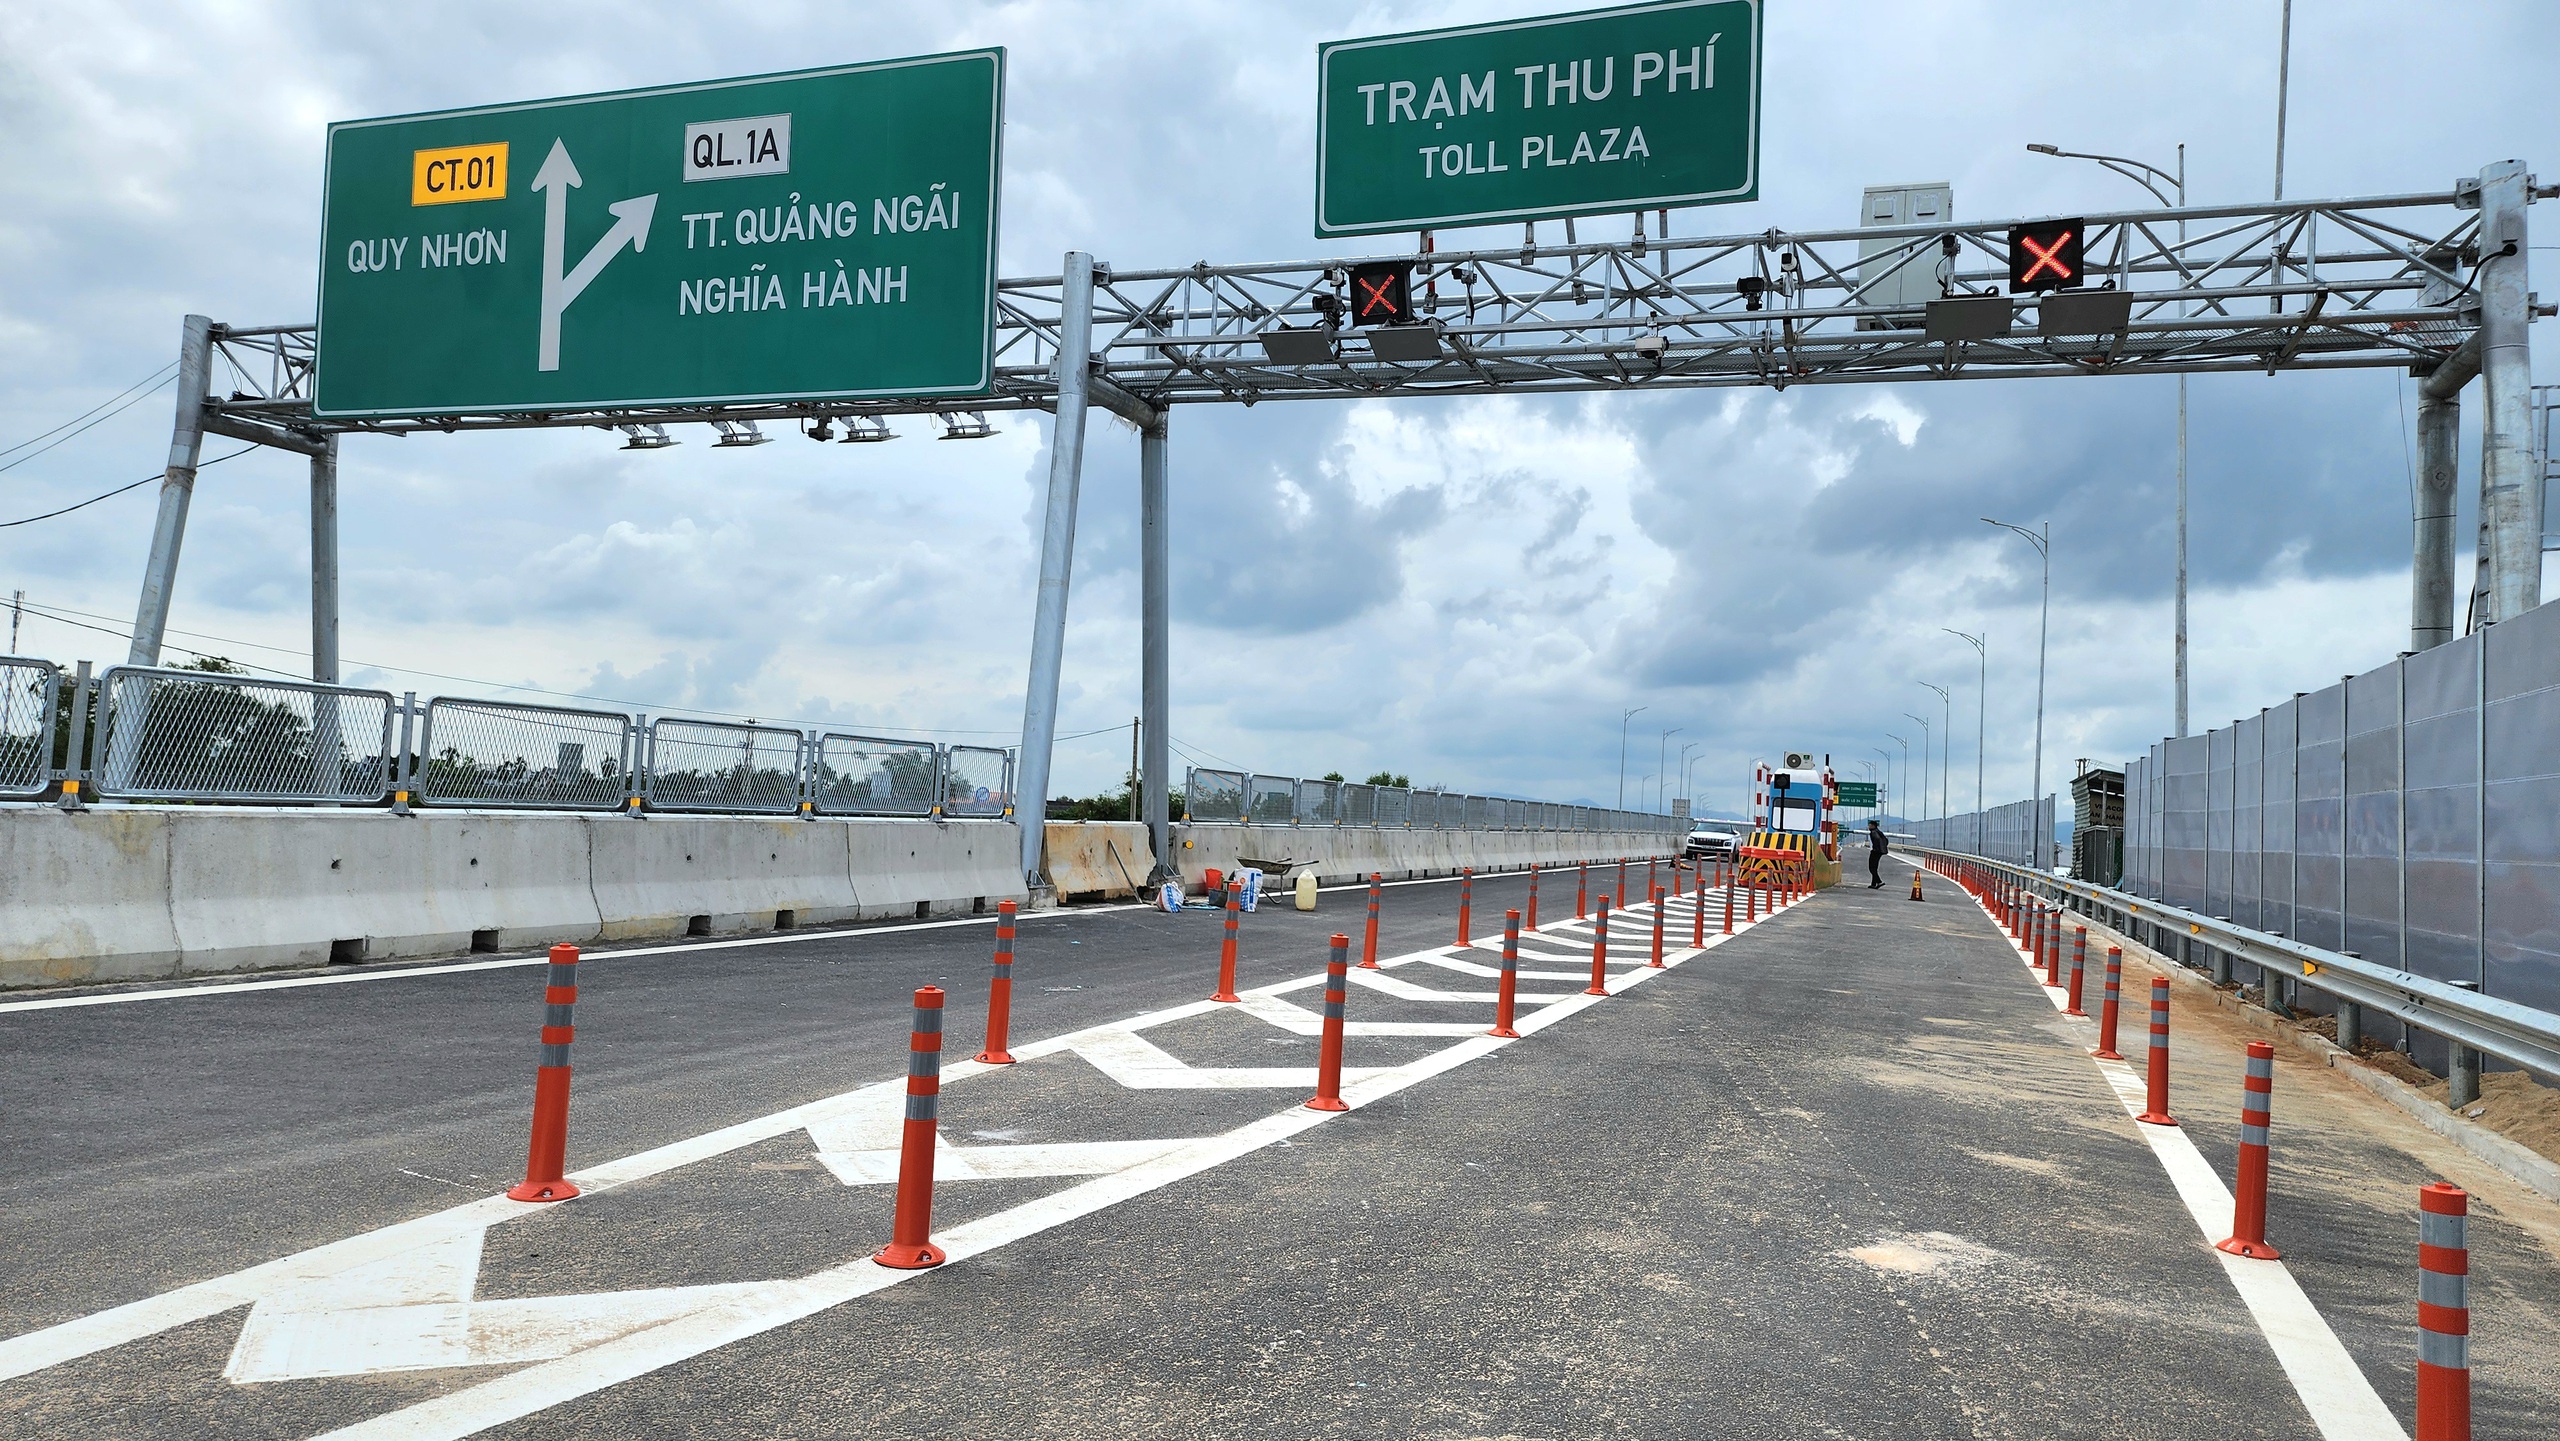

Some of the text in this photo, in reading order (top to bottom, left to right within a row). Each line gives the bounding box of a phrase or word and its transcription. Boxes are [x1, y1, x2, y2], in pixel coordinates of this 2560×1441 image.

[1357, 32, 1722, 130] TRẠM THU PHÍ
[426, 155, 494, 193] CT.01
[692, 127, 780, 169] QL.1A
[1418, 126, 1650, 179] TOLL PLAZA
[681, 182, 960, 248] TT. QUẢNG NGÃI
[348, 227, 507, 273] QUY NHƠN
[679, 258, 908, 316] NGHĨA HÀNH
